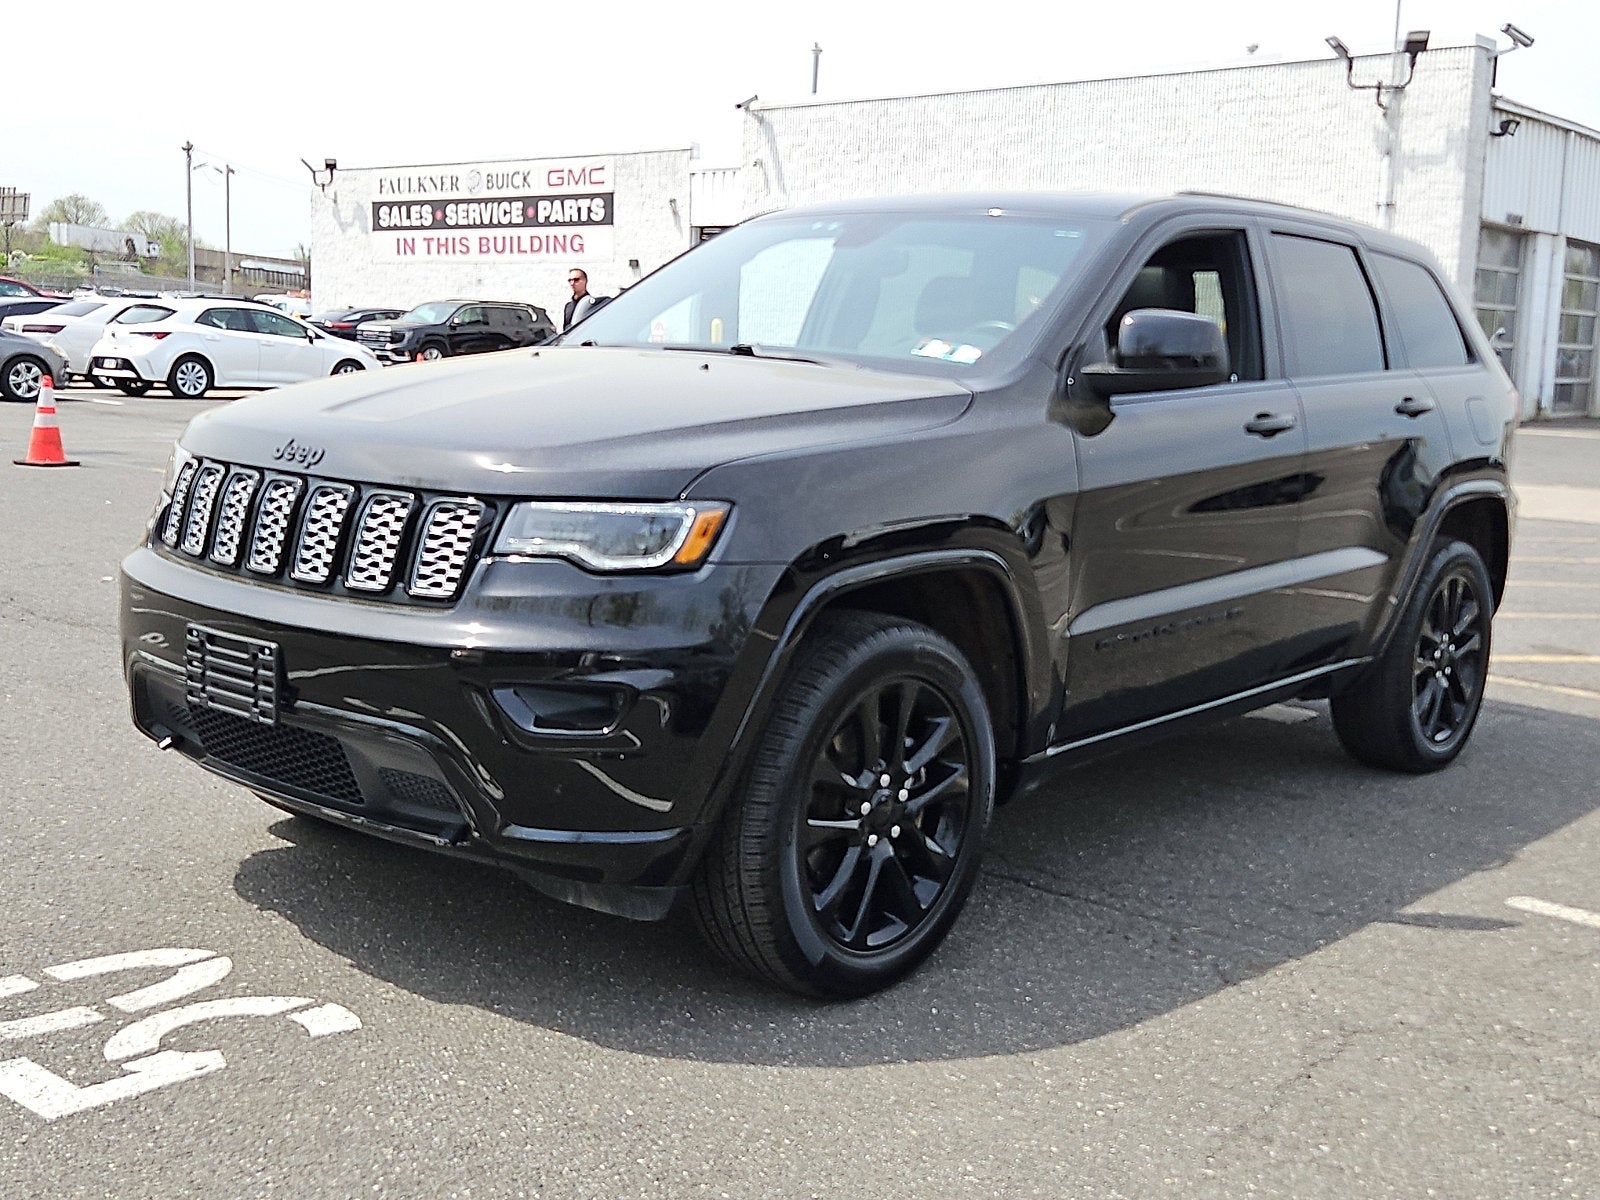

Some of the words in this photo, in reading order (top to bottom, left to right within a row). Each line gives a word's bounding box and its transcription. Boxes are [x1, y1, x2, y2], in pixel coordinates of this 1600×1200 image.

[378, 174, 460, 195] FAULKNER
[486, 170, 531, 190] BUICK
[547, 165, 606, 188] GMC
[378, 204, 434, 228] SALES
[444, 200, 524, 226] SERVICE
[536, 197, 606, 223] PARTS
[396, 237, 416, 256] IN
[423, 236, 471, 255] THIS
[478, 234, 585, 255] BUILDING
[273, 438, 326, 469] Jeep
